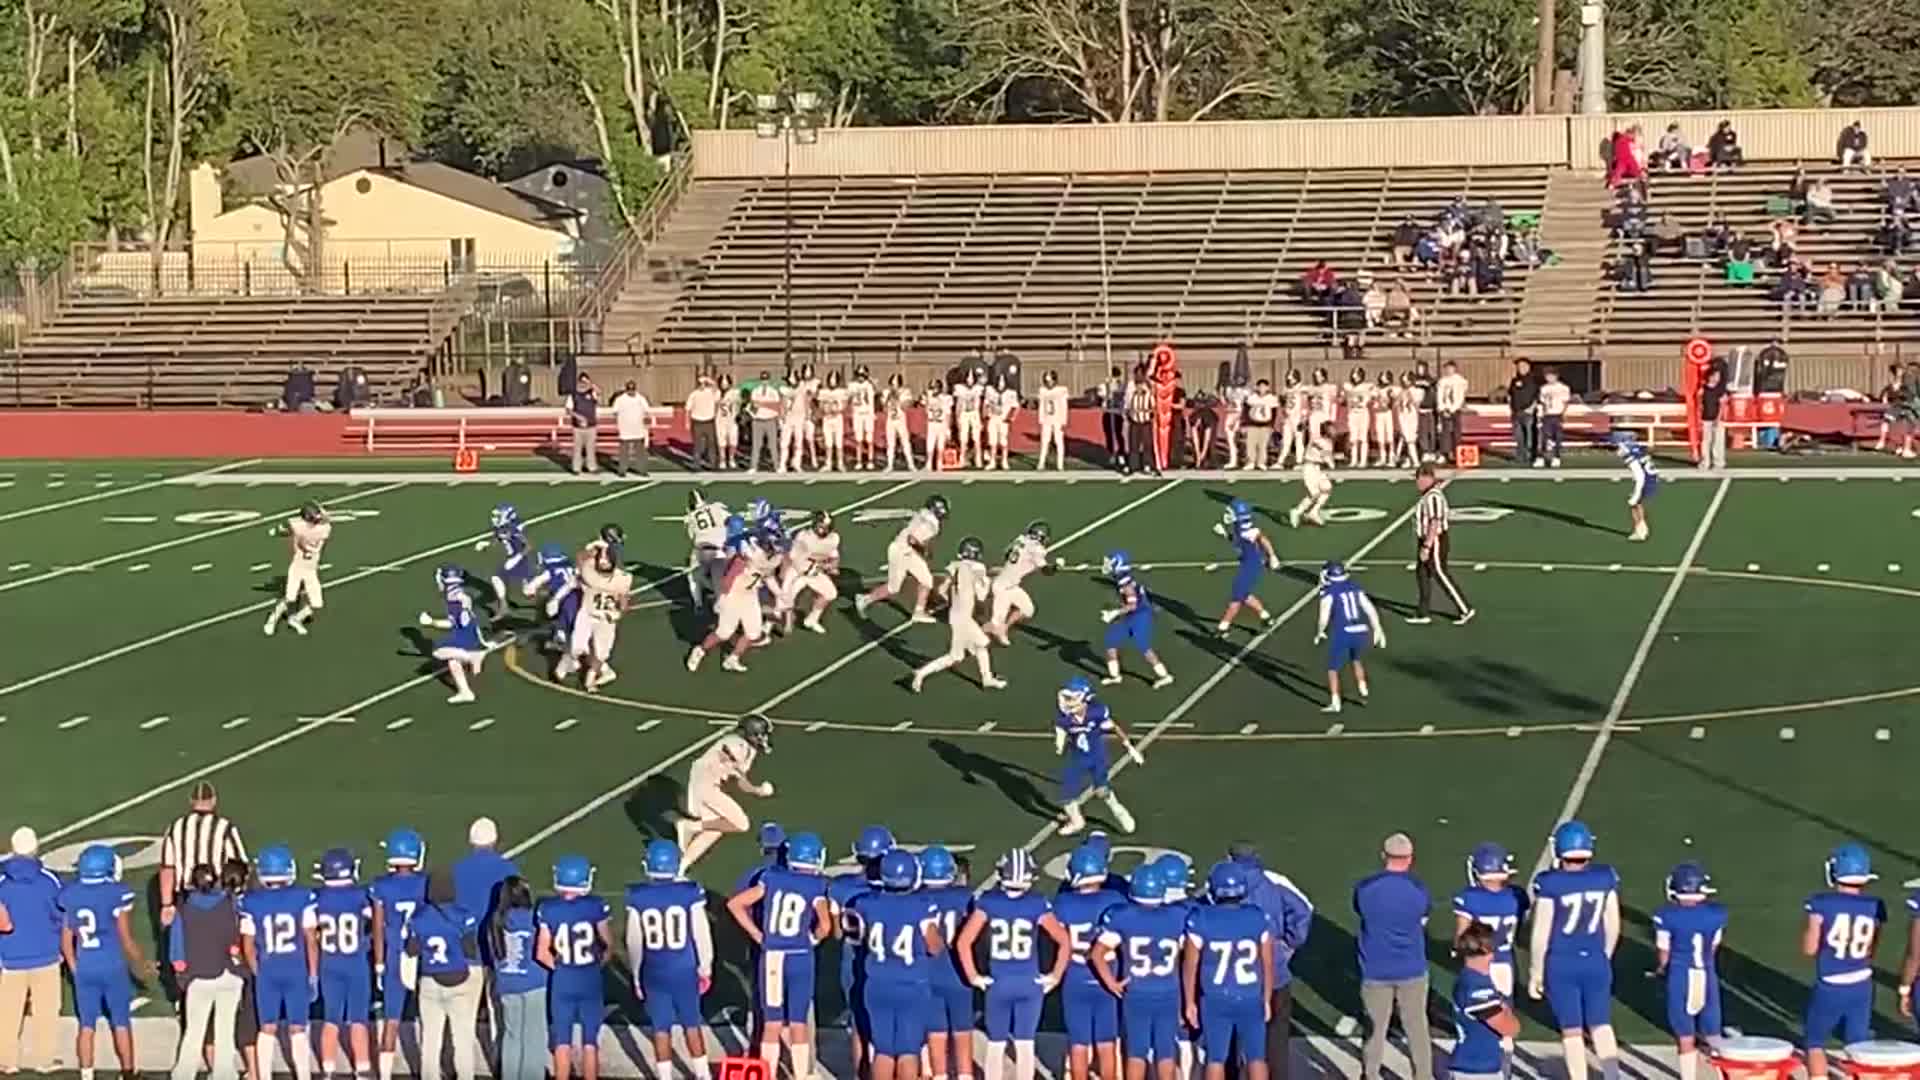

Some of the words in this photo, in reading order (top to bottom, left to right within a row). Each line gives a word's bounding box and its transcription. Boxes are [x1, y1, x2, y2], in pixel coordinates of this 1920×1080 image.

[694, 507, 716, 531] 61
[1340, 591, 1360, 622] 11
[1076, 733, 1090, 752] 4
[76, 908, 101, 949] 2
[262, 912, 298, 954] 12
[318, 912, 360, 954] 28
[640, 905, 688, 950] 80
[768, 888, 806, 938] 18
[1560, 890, 1607, 935] 77
[426, 936, 449, 965] 3
[553, 921, 596, 966] 42
[868, 921, 916, 967] 44
[990, 918, 1033, 961] 26
[1128, 936, 1181, 979] 53
[1690, 932, 1705, 968] 1
[1825, 912, 1876, 960] 48
[1209, 941, 1259, 987] 72
